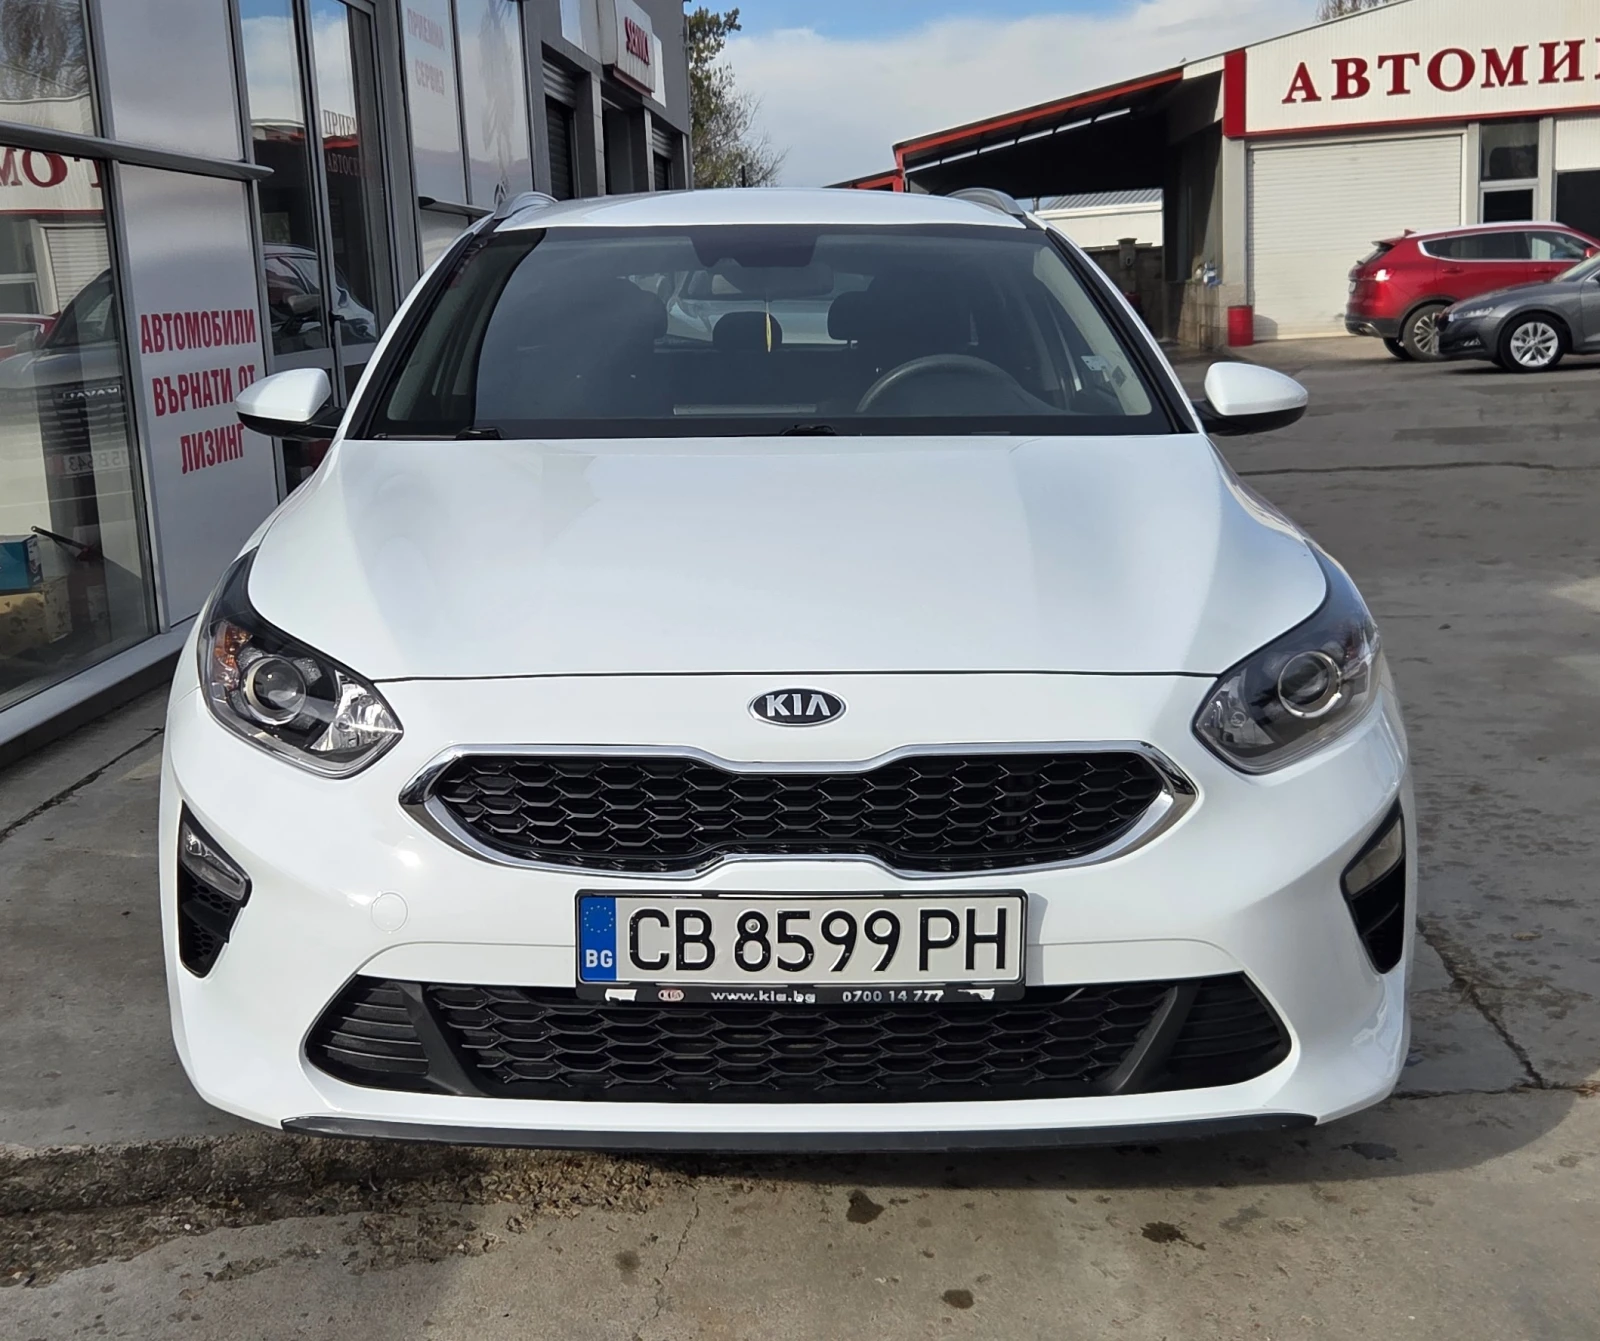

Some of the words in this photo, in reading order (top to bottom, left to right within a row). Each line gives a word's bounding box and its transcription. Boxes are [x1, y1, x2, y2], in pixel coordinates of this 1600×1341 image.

[1282, 37, 1600, 104] АВТОМИ
[140, 309, 256, 354] АВТОМОБИЛИ
[152, 367, 234, 417] ВЪРНАТИ
[238, 364, 256, 392] ОТ
[180, 423, 244, 475] ЛИЗИНГ
[765, 693, 831, 717] KIA
[585, 949, 613, 968] BG
[629, 908, 716, 972] CB
[735, 908, 901, 973] 8599
[919, 907, 1007, 972] PH
[711, 990, 816, 1004] www.kia.bg
[842, 990, 882, 1002] 0700
[889, 990, 907, 1002] 14
[913, 990, 944, 1002] 777
